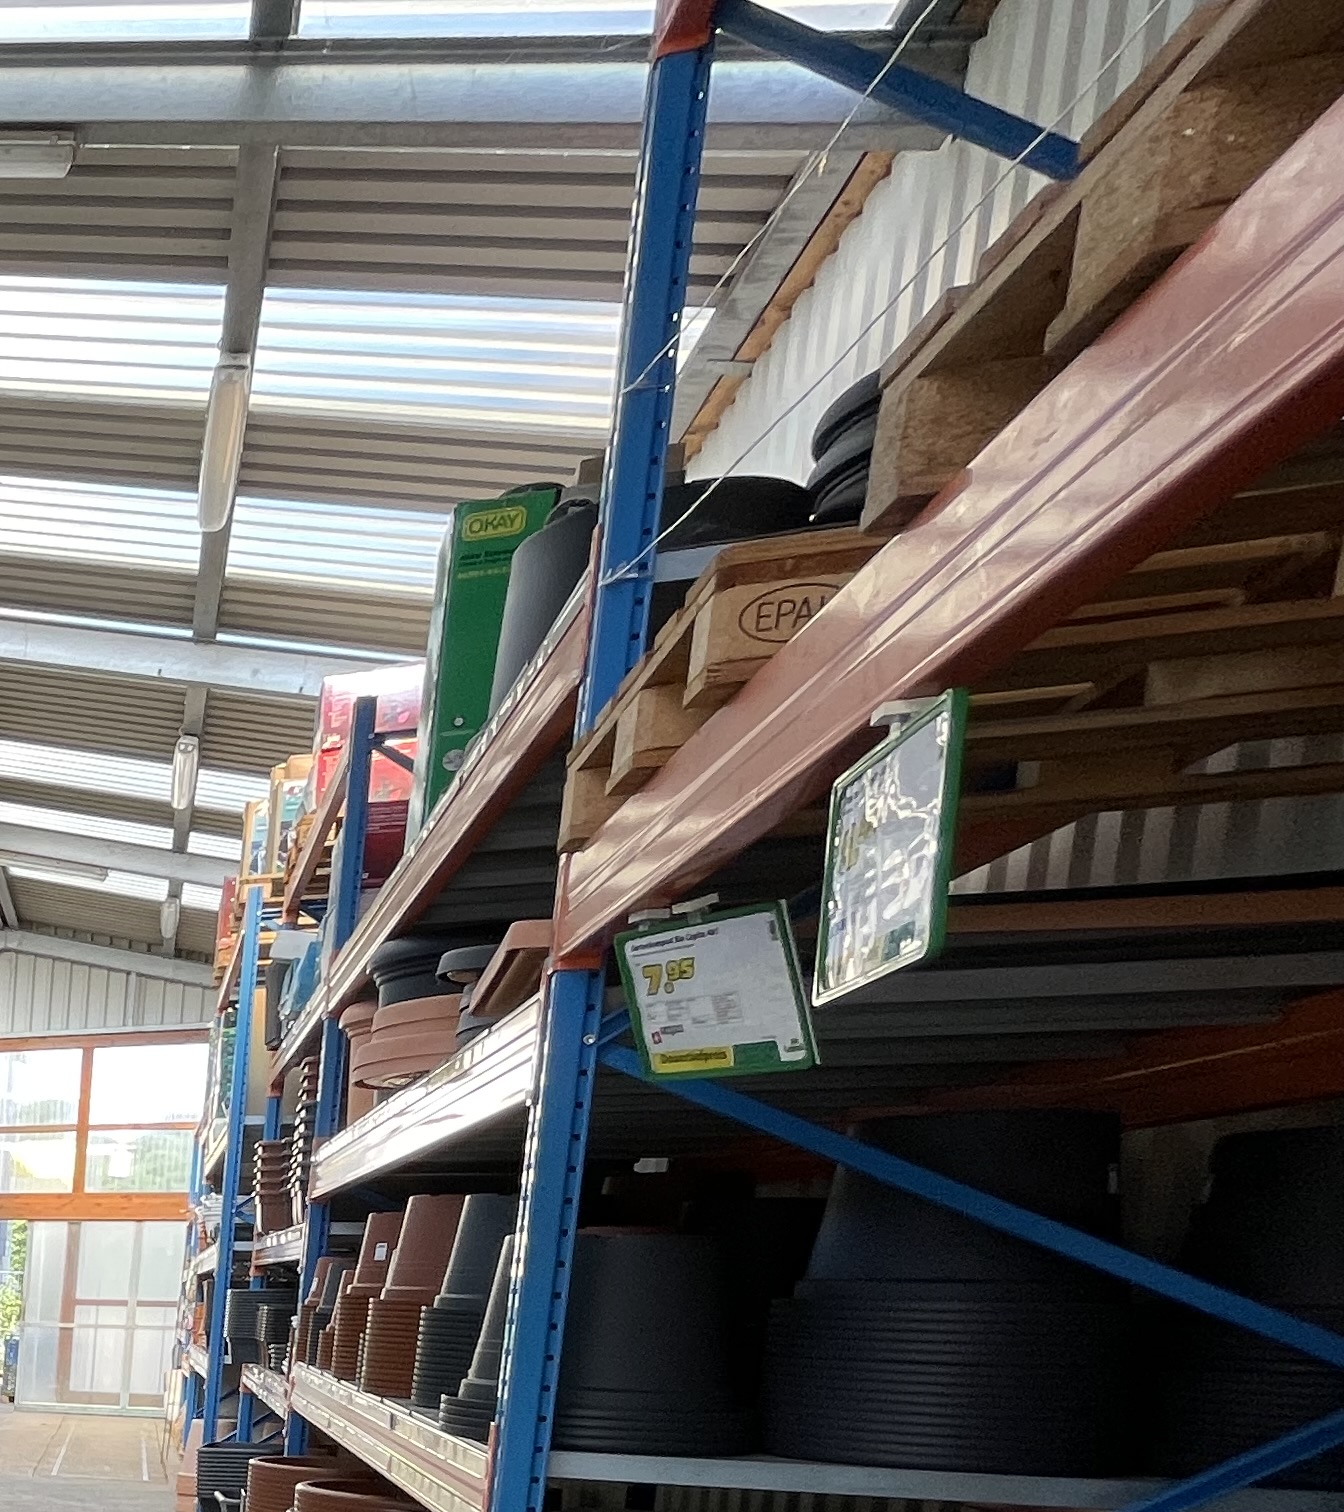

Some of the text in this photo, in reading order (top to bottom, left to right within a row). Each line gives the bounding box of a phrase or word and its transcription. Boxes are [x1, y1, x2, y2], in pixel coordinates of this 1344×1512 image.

[469, 513, 519, 533] OKAY
[755, 595, 829, 632] EPA
[642, 957, 695, 996] 7.95
